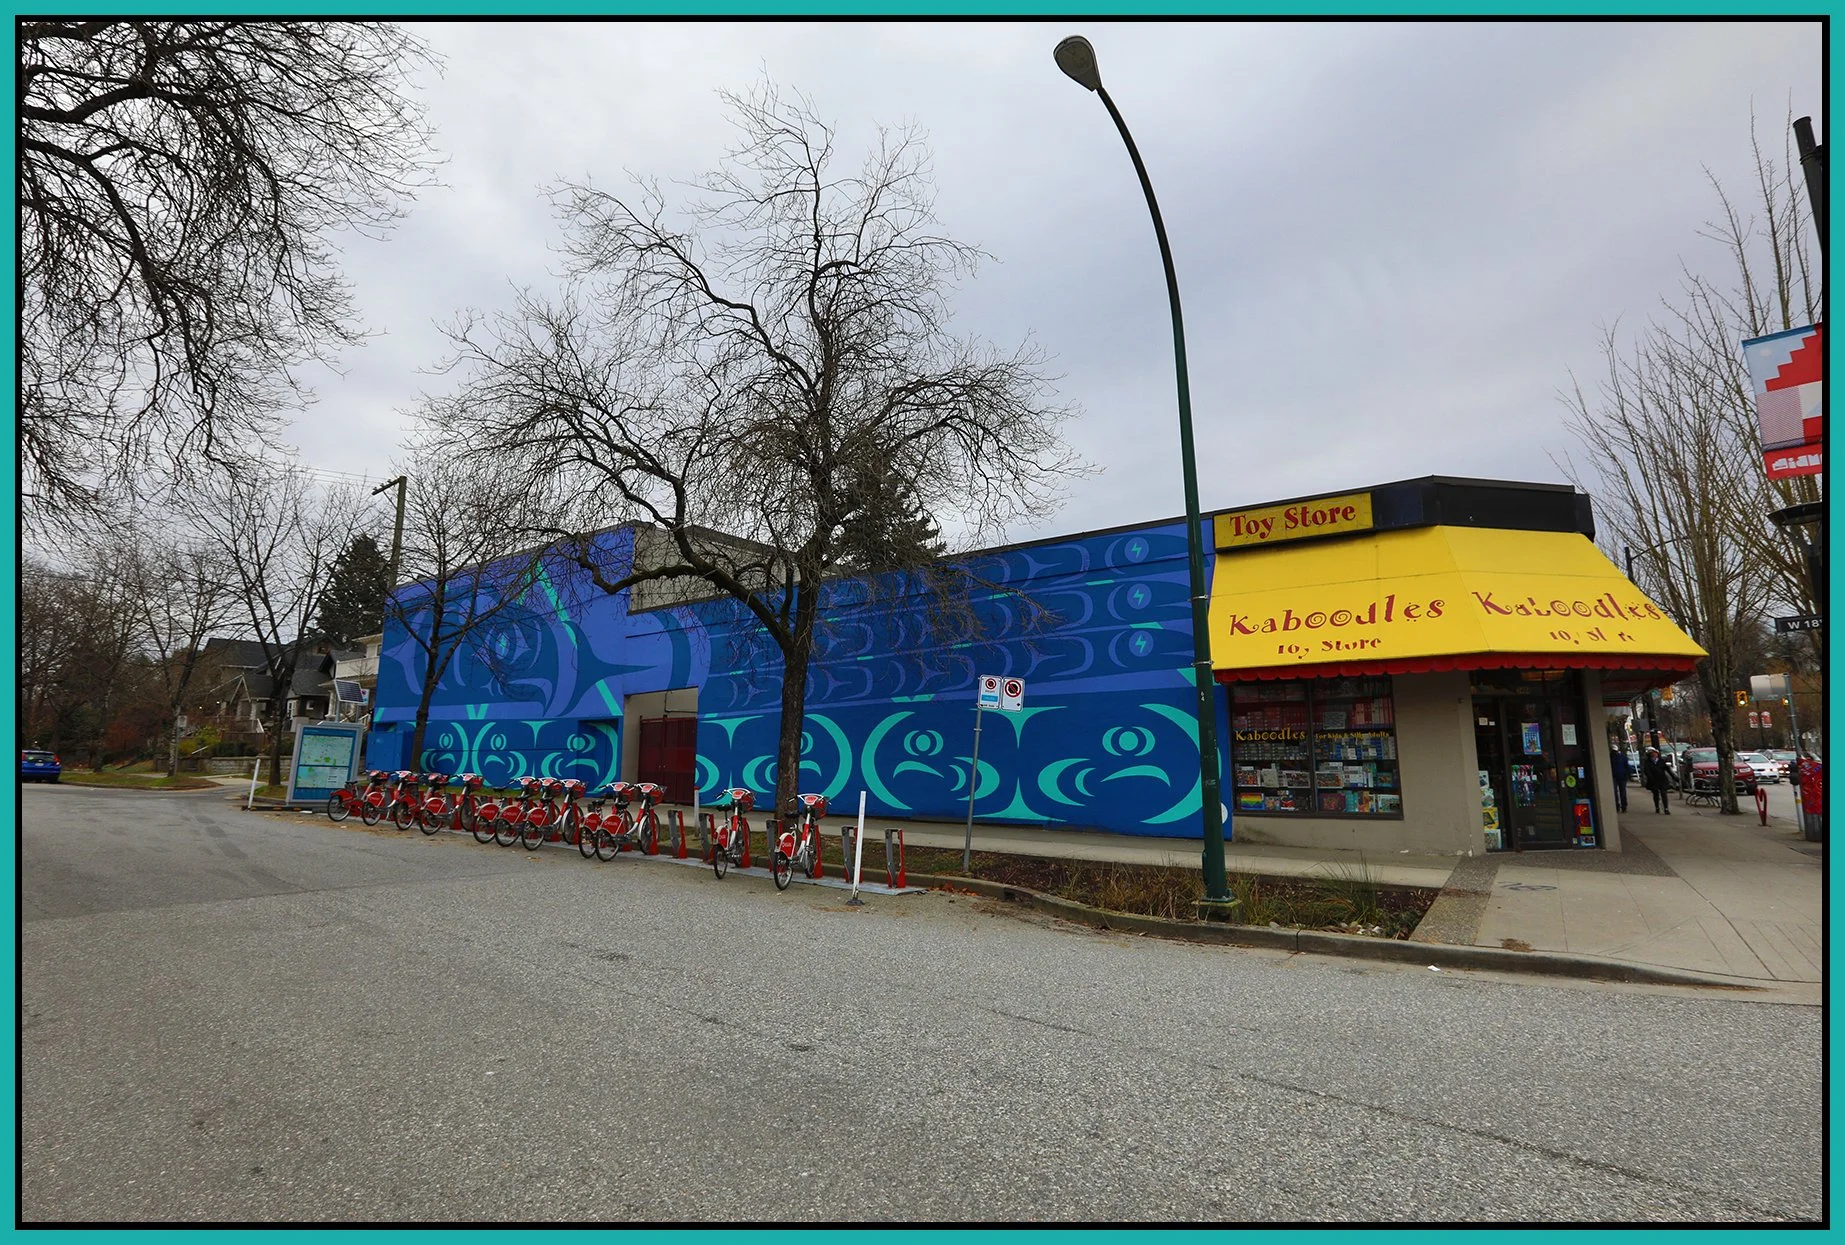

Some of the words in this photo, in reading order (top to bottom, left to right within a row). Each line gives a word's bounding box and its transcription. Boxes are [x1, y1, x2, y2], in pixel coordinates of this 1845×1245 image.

[1230, 513, 1275, 539] Toy
[1284, 505, 1356, 530] Store
[1229, 594, 1445, 636] Kaboodles
[1787, 621, 1800, 629] W
[1804, 619, 1822, 628] 18
[1235, 727, 1306, 741] Kaboodles
